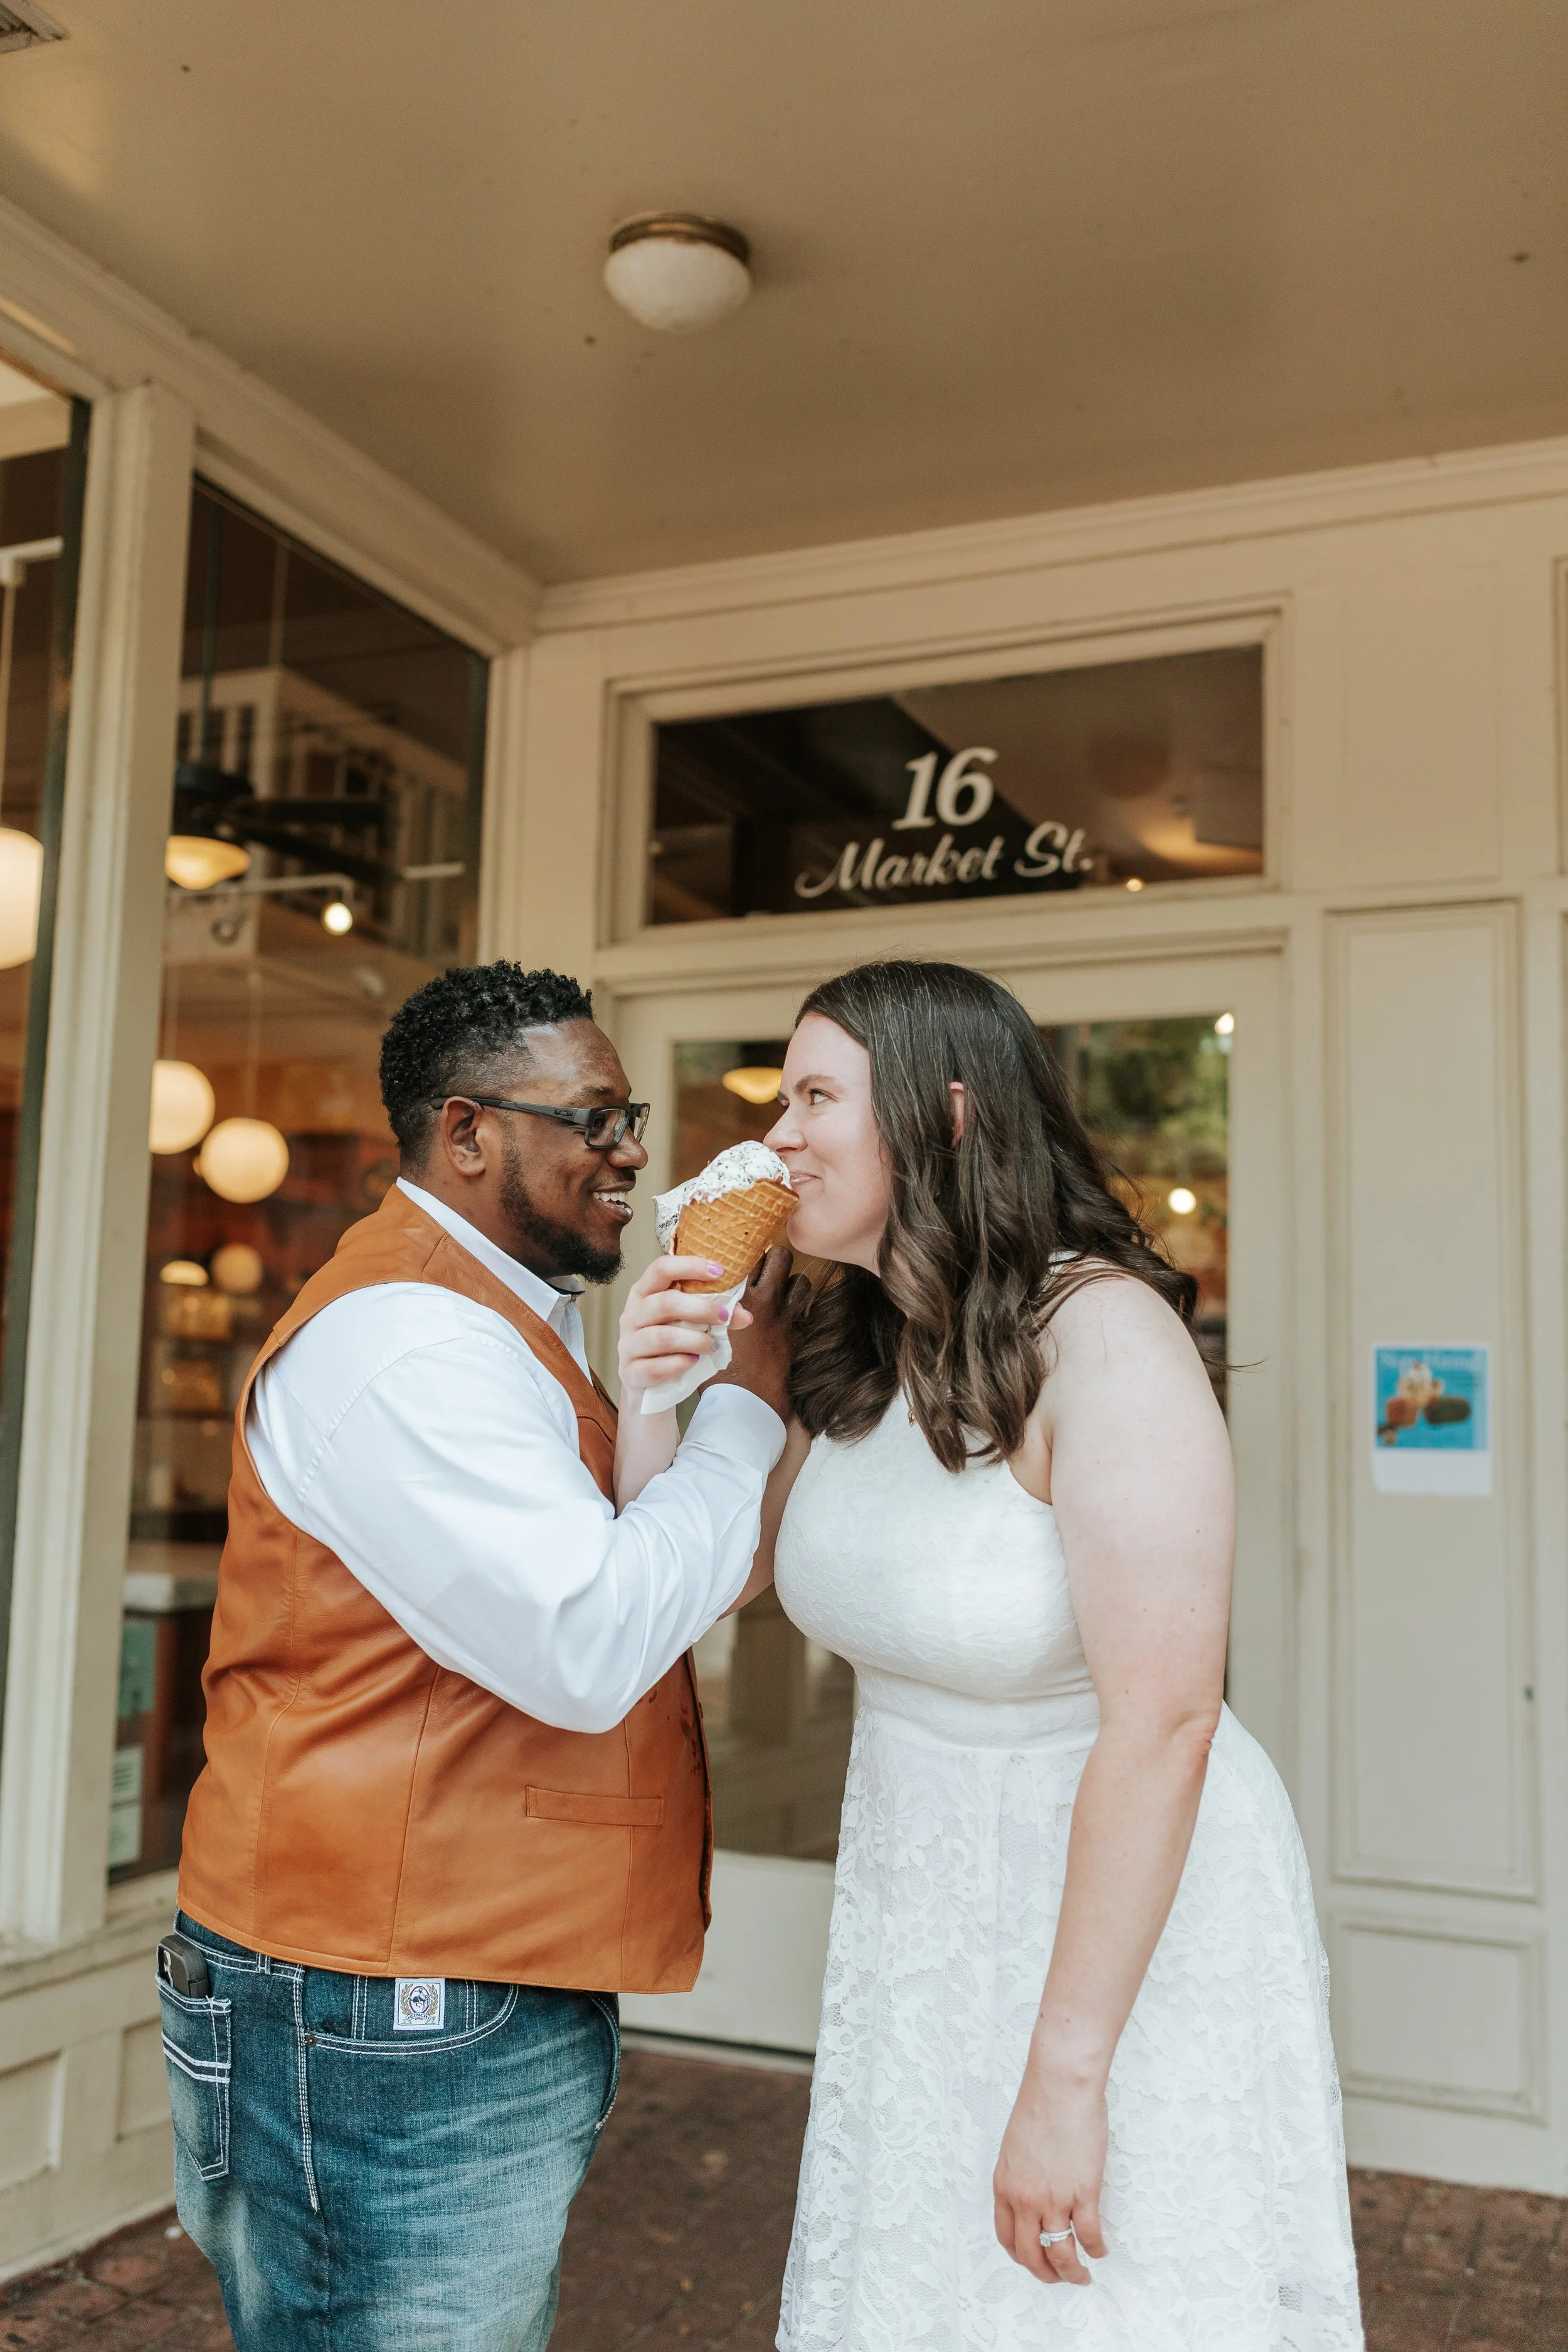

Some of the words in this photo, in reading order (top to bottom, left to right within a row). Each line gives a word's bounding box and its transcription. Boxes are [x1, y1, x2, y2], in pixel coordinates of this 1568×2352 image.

[892, 746, 997, 830] 16
[795, 834, 1005, 899] Market
[1014, 820, 1094, 877] St.
